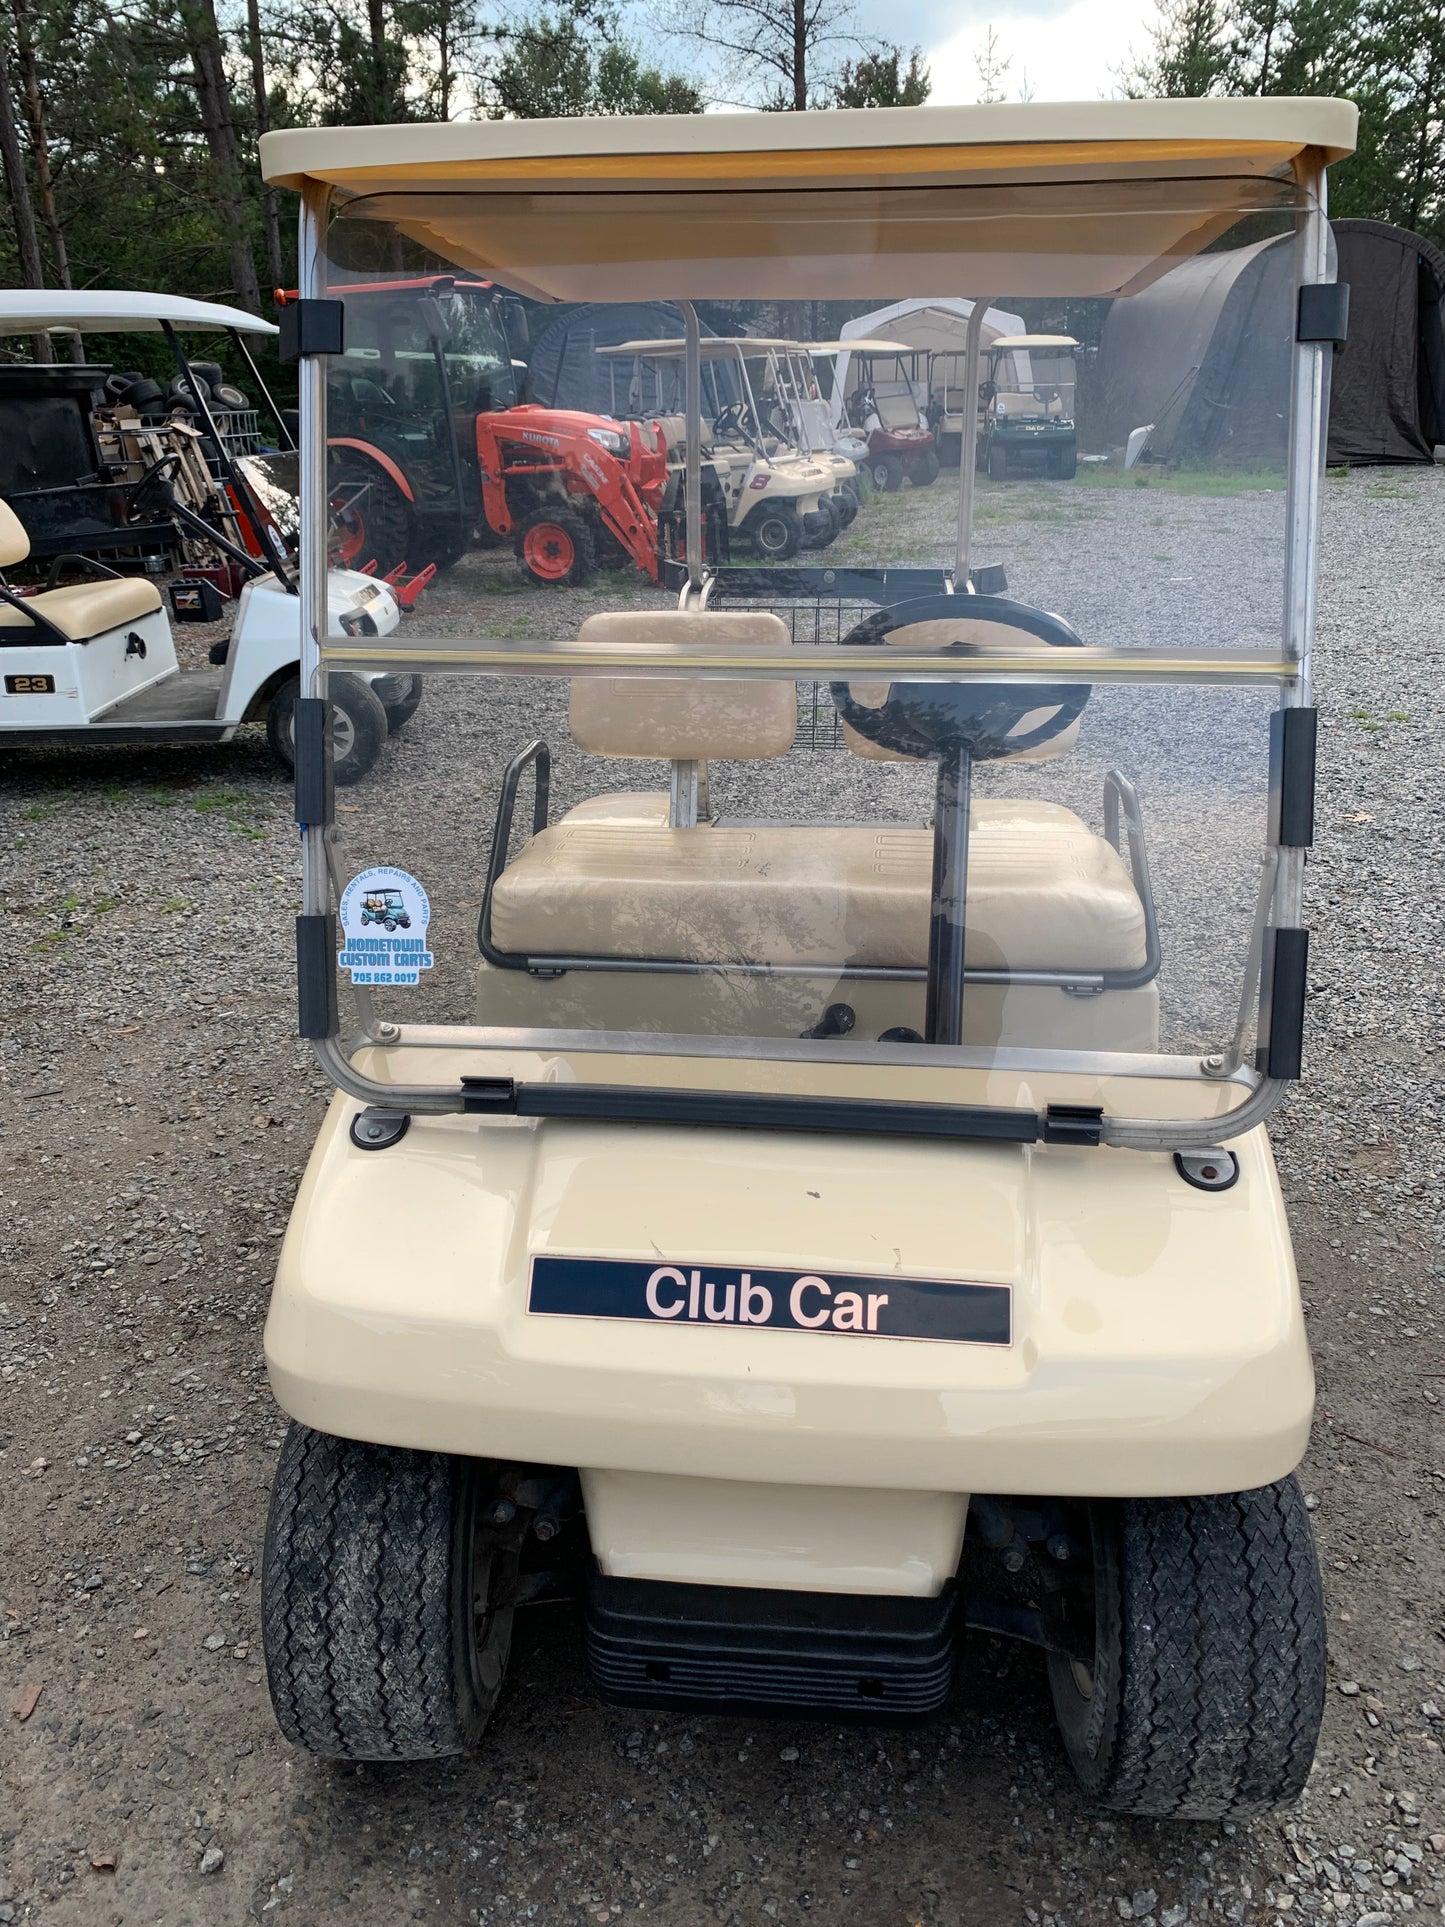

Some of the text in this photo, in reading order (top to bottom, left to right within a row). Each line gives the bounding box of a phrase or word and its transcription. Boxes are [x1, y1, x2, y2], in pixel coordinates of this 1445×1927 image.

[522, 431, 560, 447] KUBOTA
[749, 473, 772, 490] 8
[14, 677, 48, 692] 23
[377, 868, 413, 883] REPAIRS
[410, 882, 424, 897] AND
[421, 898, 430, 925] PARTS
[346, 938, 424, 952] HOMETOWN
[339, 952, 432, 967] CUSTOM CARTS
[353, 972, 417, 983] 705 862 0017
[645, 1266, 889, 1332] Club Car
